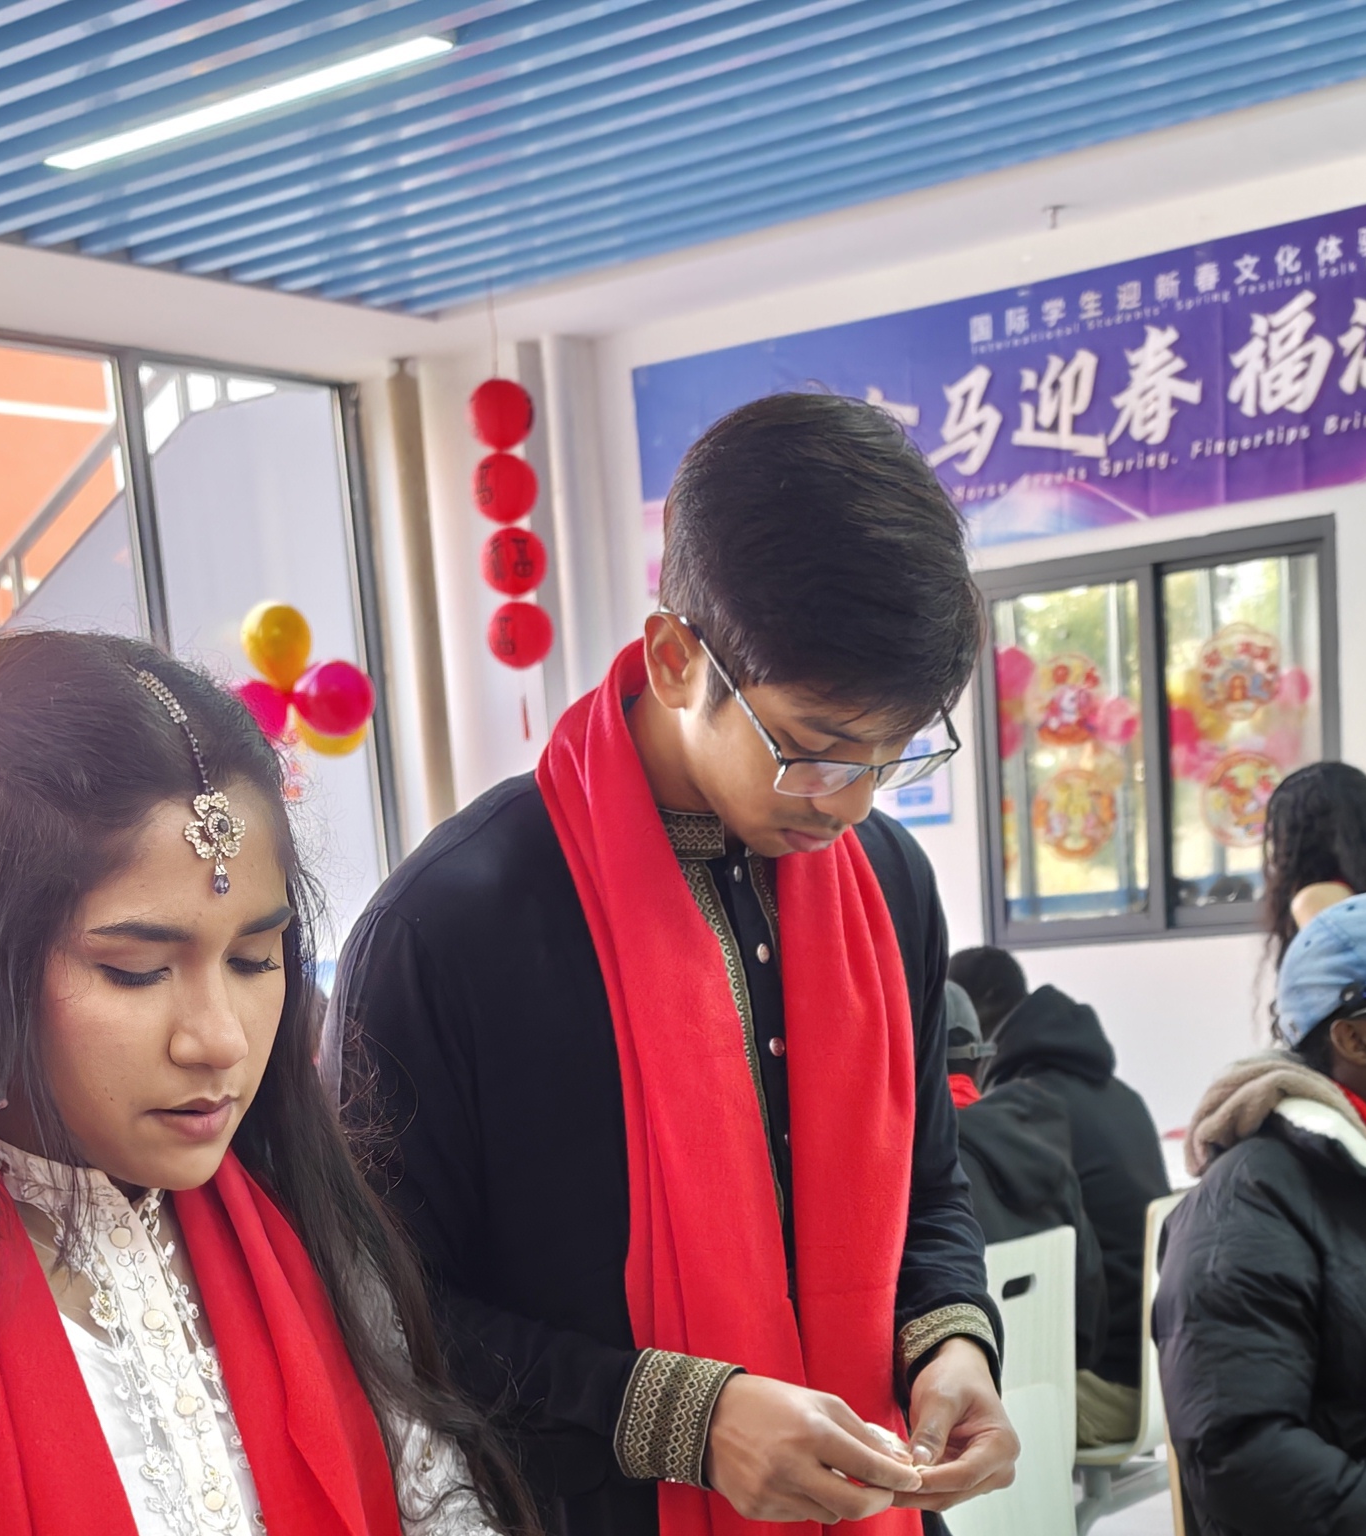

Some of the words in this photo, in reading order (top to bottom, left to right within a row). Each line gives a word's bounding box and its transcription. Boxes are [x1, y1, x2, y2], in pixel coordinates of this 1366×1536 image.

[971, 323, 1080, 355] International
[1176, 289, 1231, 312] Spring
[1238, 271, 1312, 296] Festival
[1319, 261, 1358, 280] Folk
[1190, 424, 1311, 459] Fingertips
